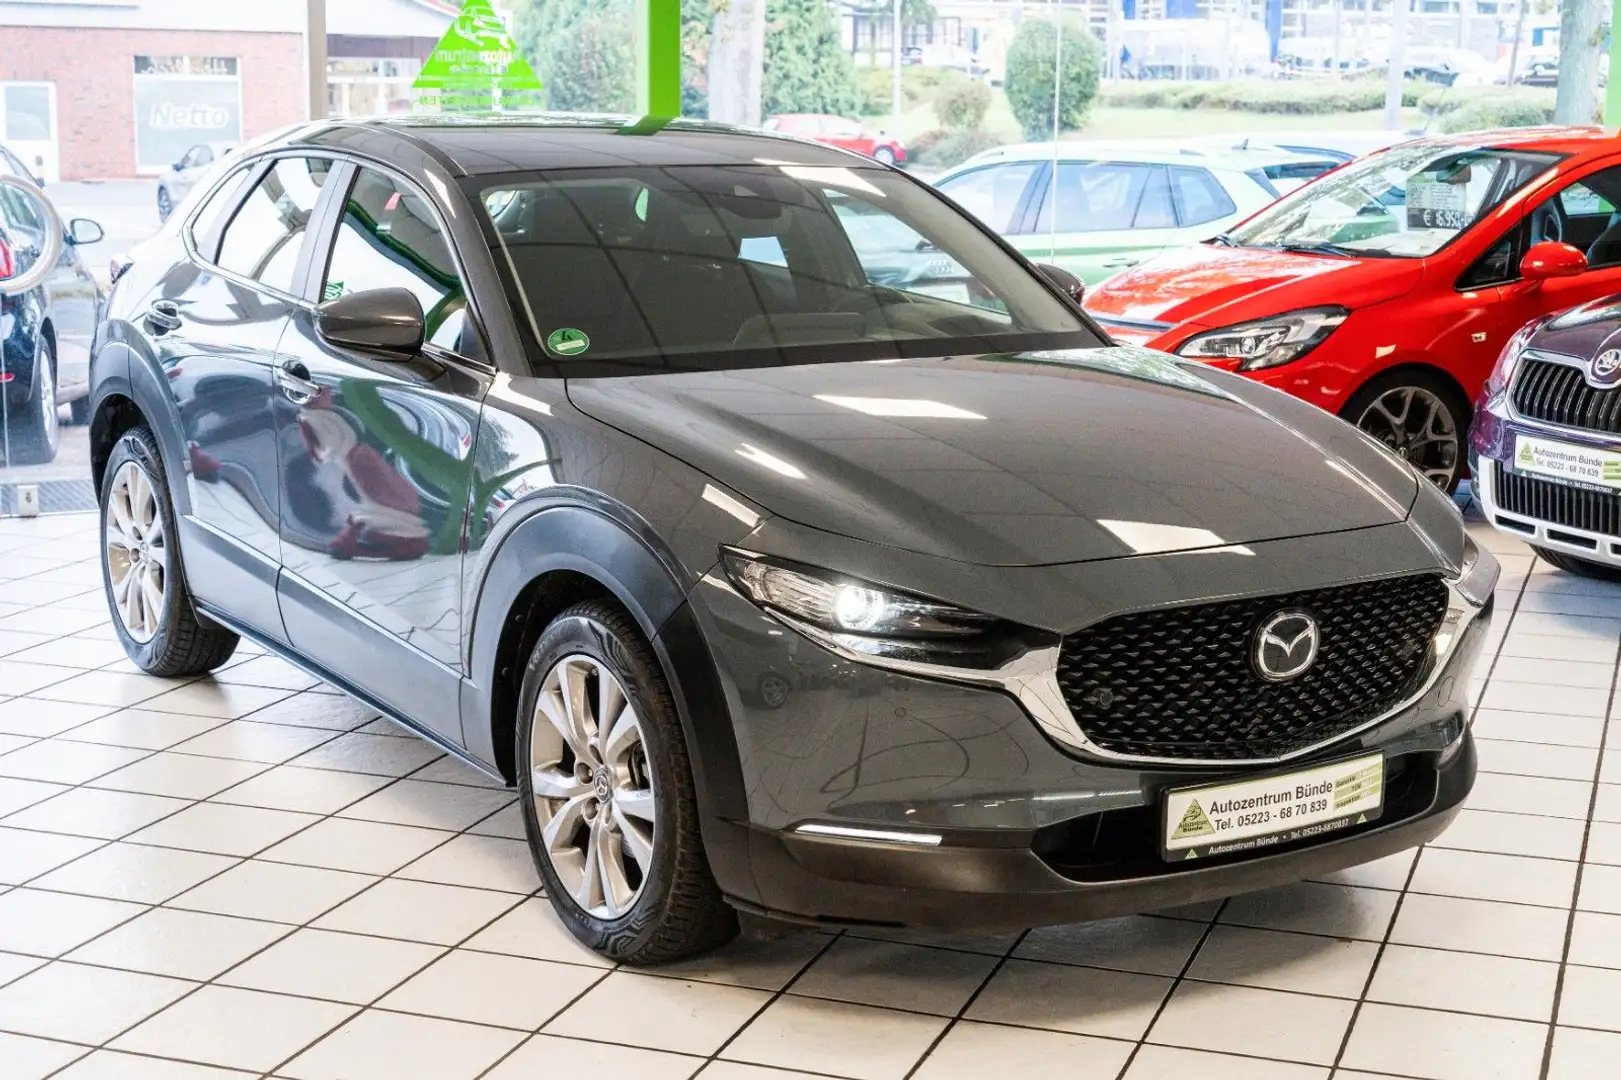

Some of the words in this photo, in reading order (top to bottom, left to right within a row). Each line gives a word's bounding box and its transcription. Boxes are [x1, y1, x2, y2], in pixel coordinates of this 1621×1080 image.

[150, 102, 229, 128] Netto
[1533, 446, 1577, 463] Autozentrum
[1578, 454, 1603, 468] Bünde
[1209, 791, 1292, 815] Autozentrum
[1296, 780, 1333, 799] Bünde
[1214, 819, 1234, 831] Tel.
[1238, 811, 1270, 827] 05223
[1280, 806, 1292, 819] 68
[1296, 803, 1307, 816] 70
[1310, 799, 1327, 813] 839
[1208, 840, 1255, 856] Autozentrum
[1256, 835, 1279, 847] Bünde
[1291, 829, 1301, 839] Tel.
